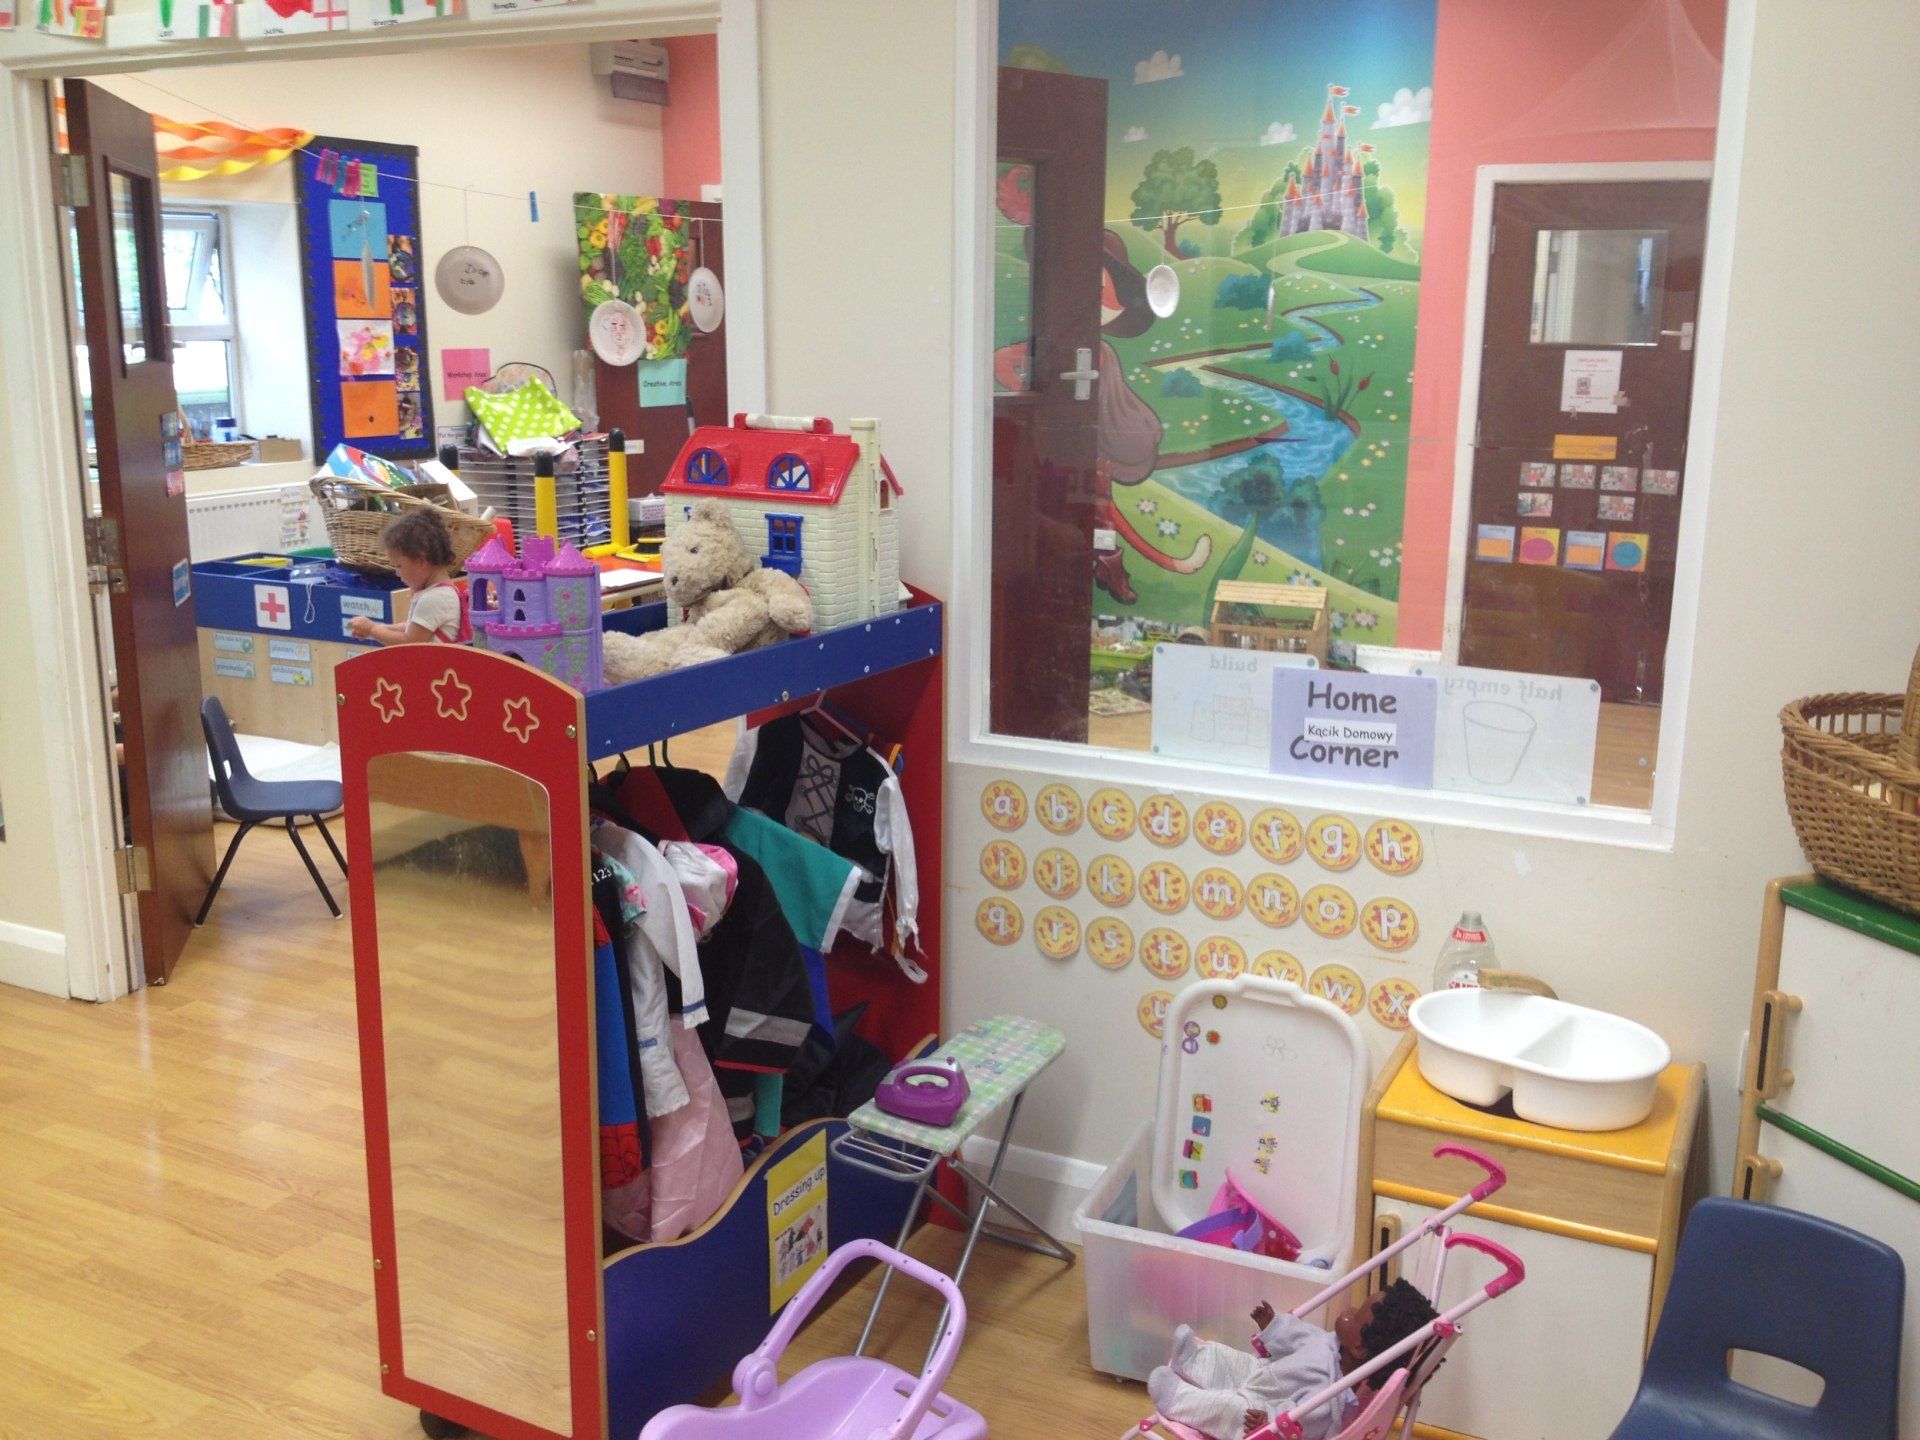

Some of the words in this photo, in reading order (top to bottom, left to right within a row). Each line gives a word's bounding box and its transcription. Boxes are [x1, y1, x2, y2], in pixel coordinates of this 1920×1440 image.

[342, 600, 370, 611] watch
[1307, 681, 1397, 714] Home
[1289, 734, 1399, 769] Corner
[1308, 724, 1339, 738] Kącik
[1343, 726, 1393, 743] Domowy
[994, 796, 1012, 816] a
[1050, 793, 1069, 823] b
[1103, 805, 1118, 825] c
[1151, 805, 1173, 837] d
[1209, 817, 1227, 838] e
[1268, 818, 1282, 850] f
[1321, 825, 1343, 858] g
[1380, 828, 1405, 862] h
[999, 850, 1009, 878] i
[1052, 854, 1063, 892] j
[1103, 863, 1121, 896] k
[1159, 871, 1169, 902] l
[1202, 882, 1235, 907] m
[1262, 886, 1285, 911] n
[1319, 899, 1341, 920] o
[1380, 907, 1401, 941] p
[989, 906, 1008, 937] q
[1052, 920, 1063, 941] r
[1104, 931, 1118, 949] s
[1158, 941, 1171, 965] t
[1211, 952, 1232, 973] u
[1322, 978, 1354, 1002] w
[1387, 992, 1408, 1015] x
[773, 1176, 812, 1217] Dressing
[814, 1167, 826, 1182] up
